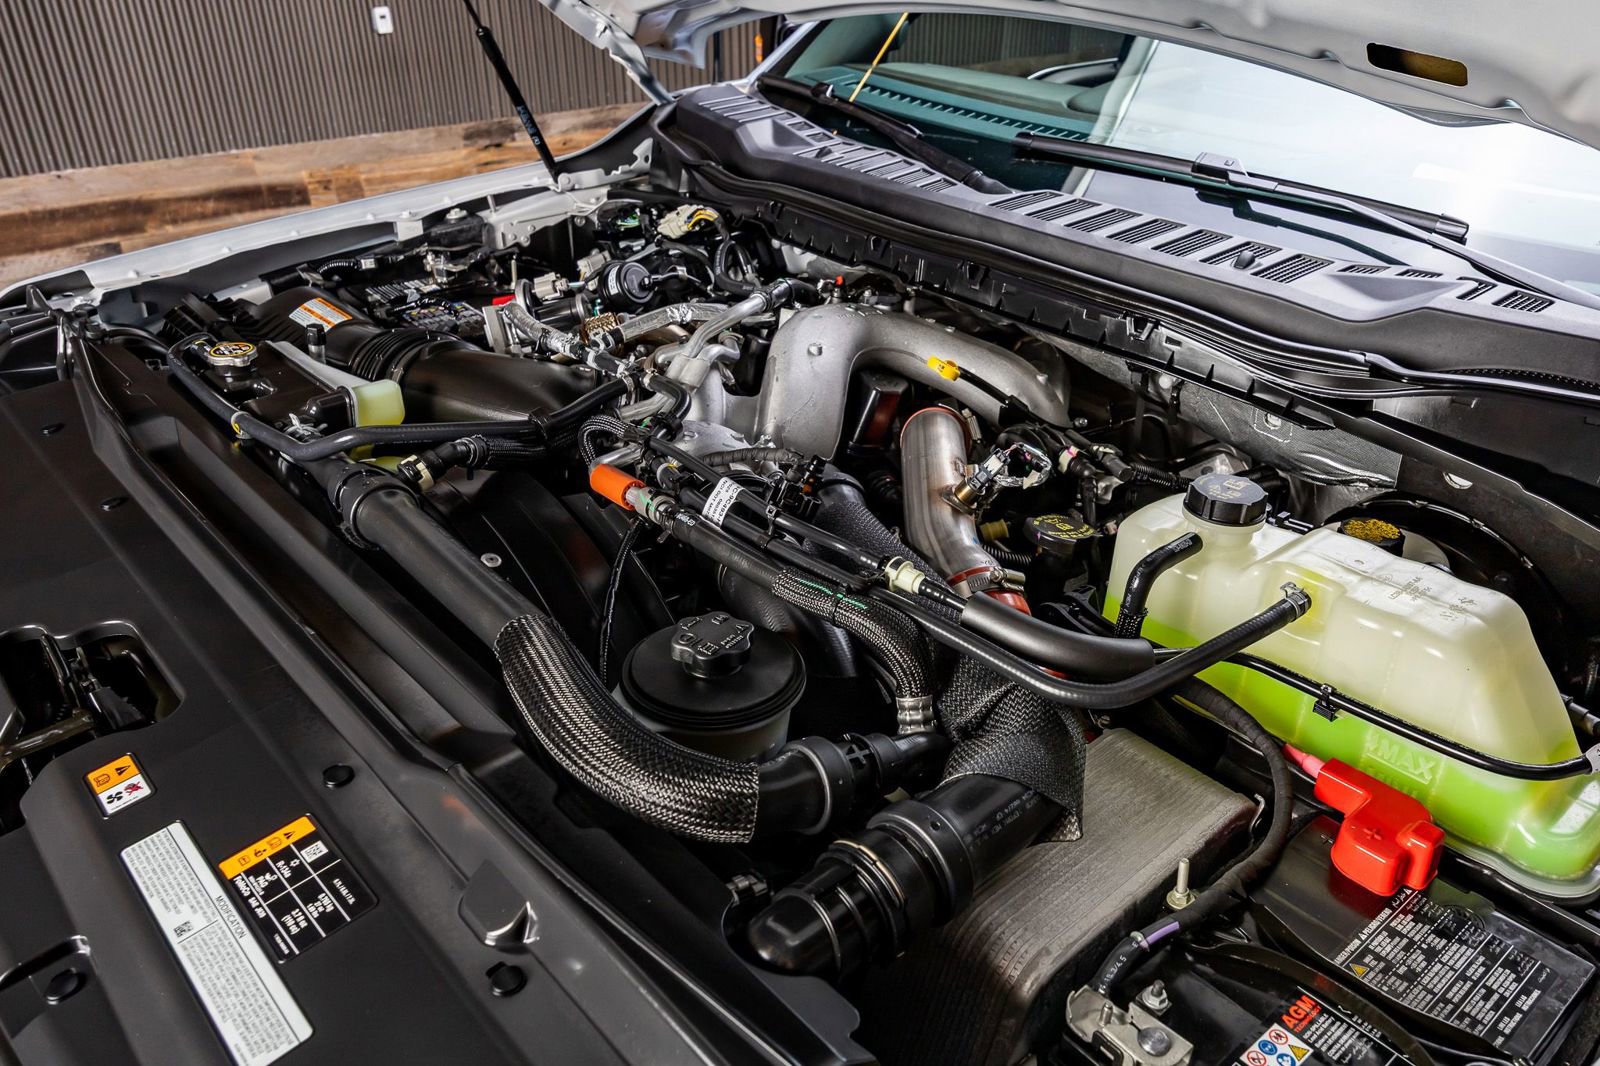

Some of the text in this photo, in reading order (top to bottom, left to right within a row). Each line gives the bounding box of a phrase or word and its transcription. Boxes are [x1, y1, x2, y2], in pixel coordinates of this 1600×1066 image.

[256, 876, 268, 888] PAG
[216, 896, 246, 938] MODIFICATION
[1281, 994, 1318, 1030] AGM
